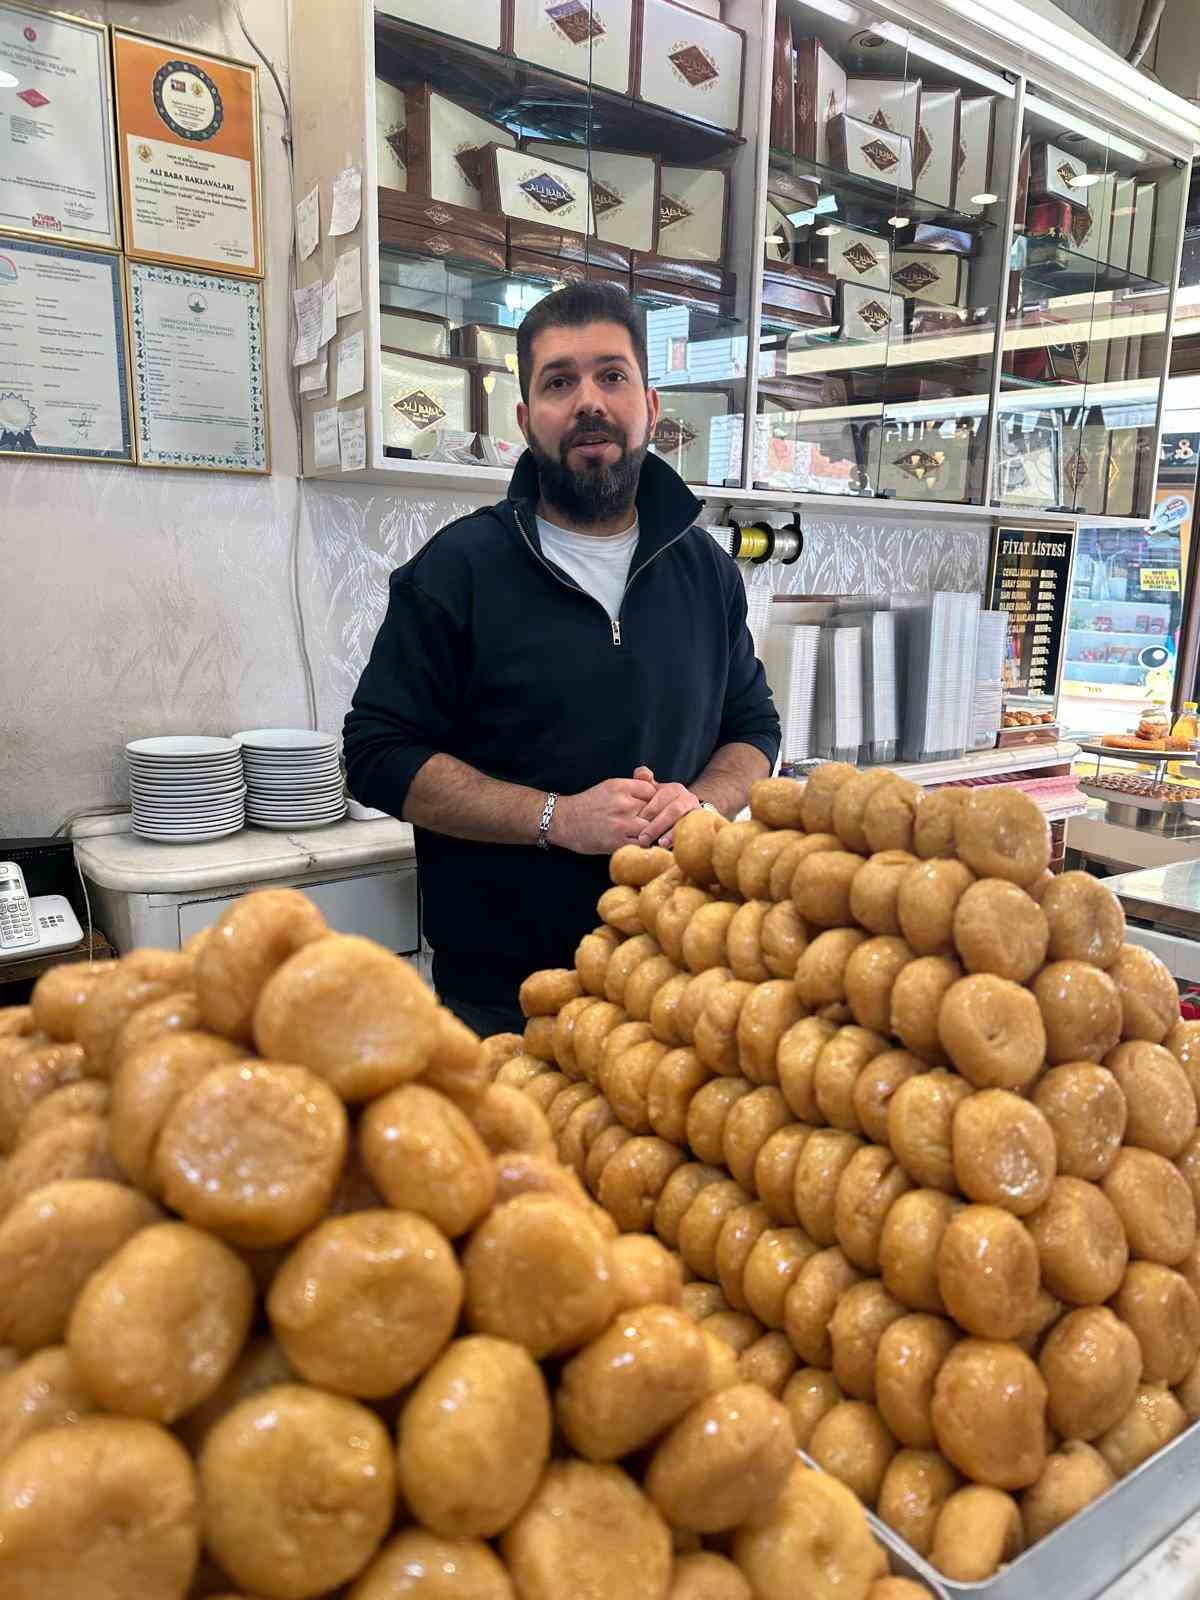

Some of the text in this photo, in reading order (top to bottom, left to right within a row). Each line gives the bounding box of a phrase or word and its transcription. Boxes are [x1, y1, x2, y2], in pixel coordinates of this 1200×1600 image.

[163, 169, 183, 181] BABA
[1002, 539, 1067, 557] FİYAT LİSTESİ
